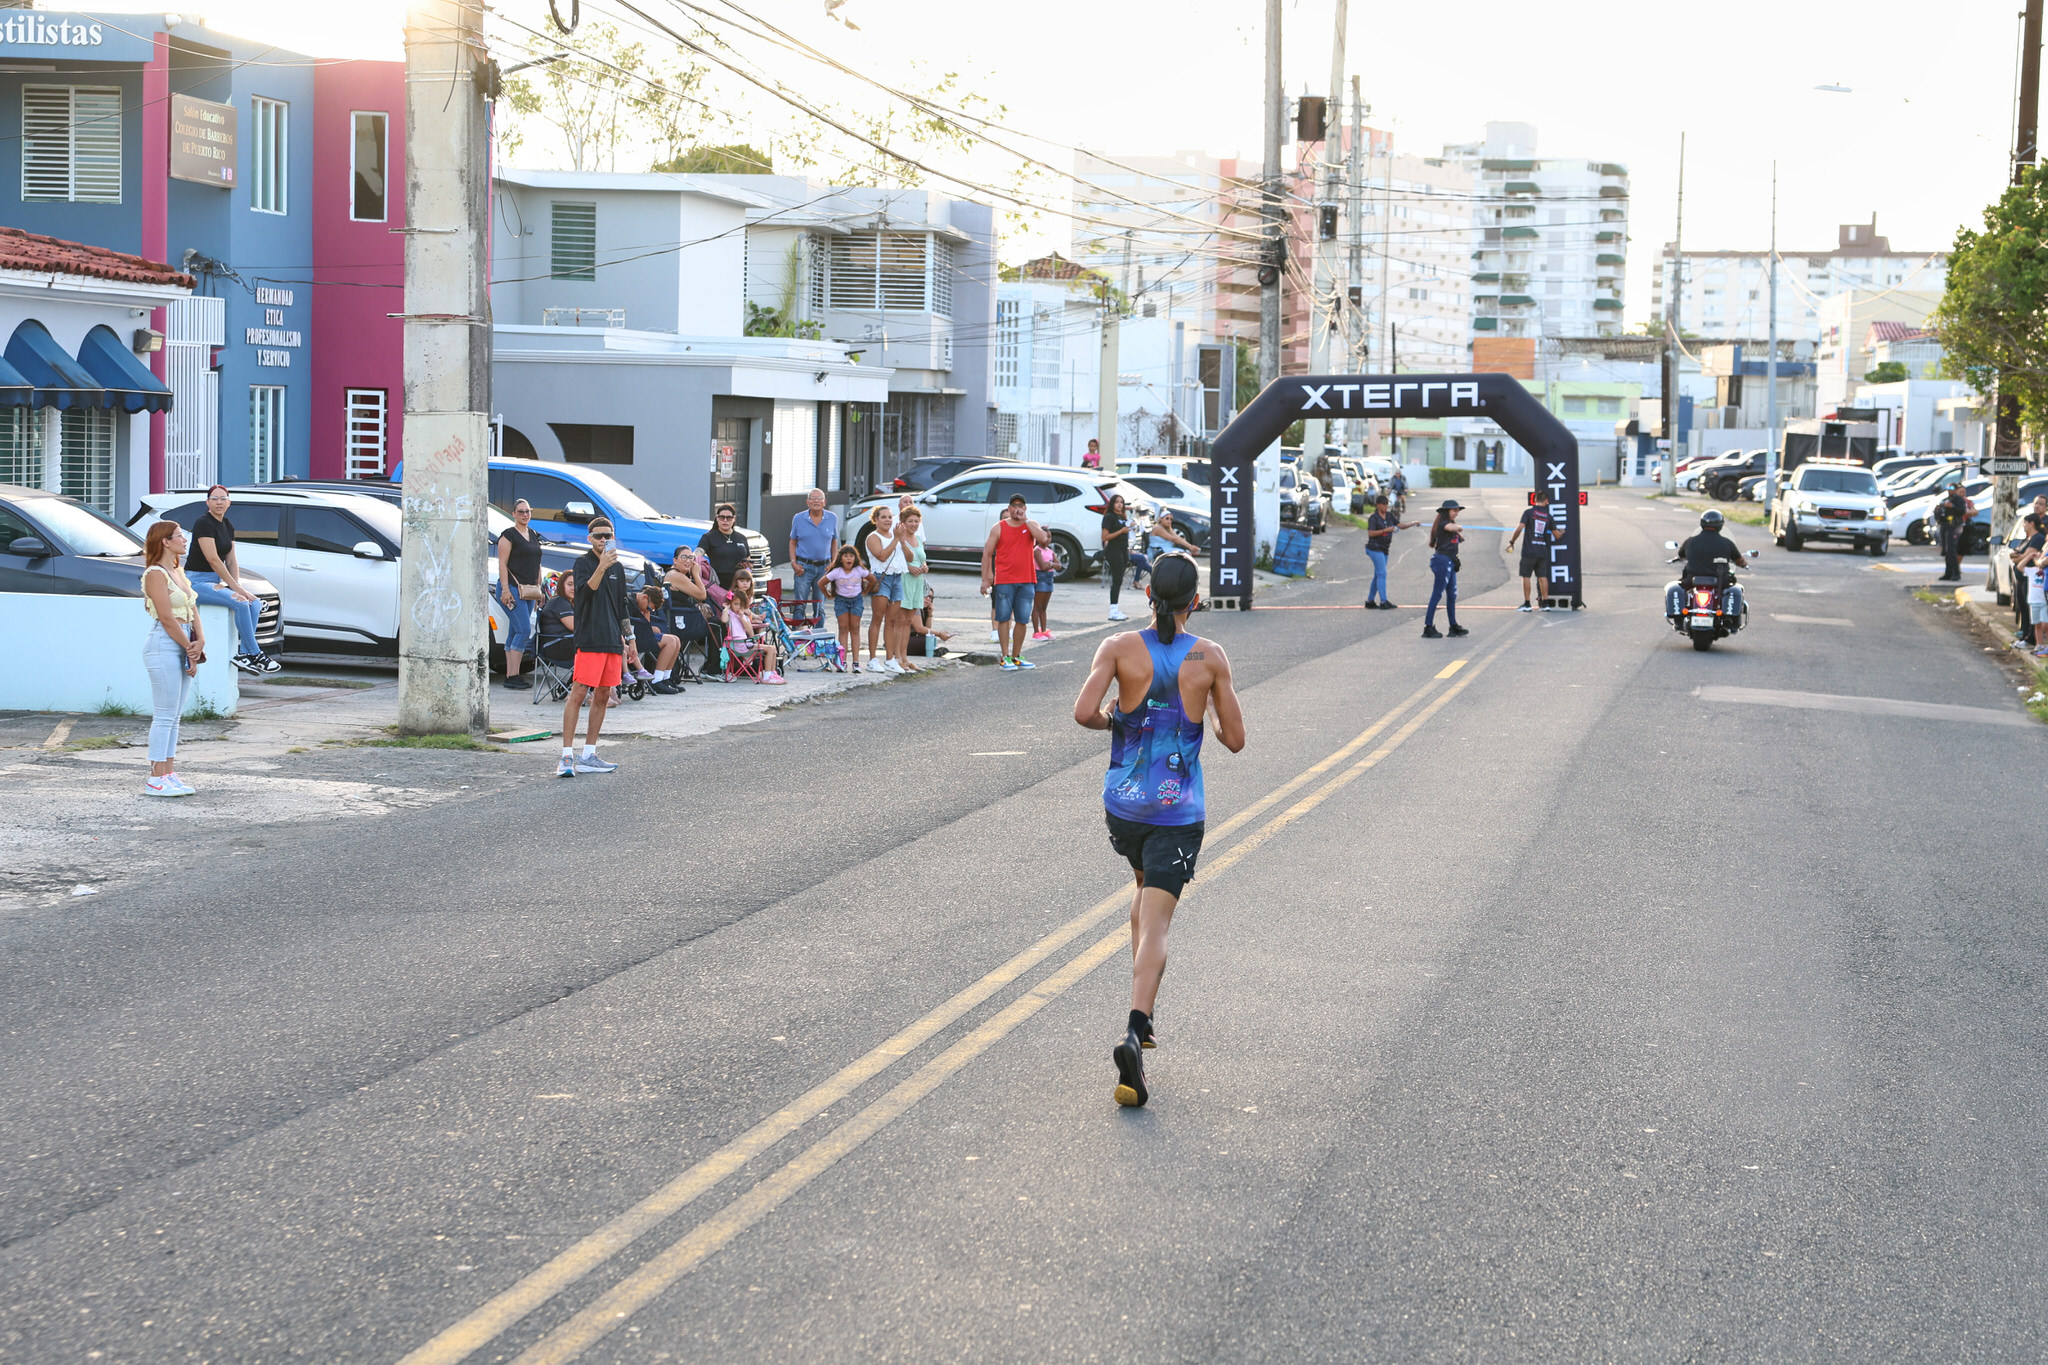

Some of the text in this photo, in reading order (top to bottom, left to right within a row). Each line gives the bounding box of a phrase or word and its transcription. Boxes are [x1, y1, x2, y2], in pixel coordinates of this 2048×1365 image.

[175, 121, 233, 145] COLEGIO DE BARBEROS
[182, 142, 226, 160] DE PUERTO RICO
[256, 287, 294, 306] HERMANDAD
[266, 309, 283, 326] ETICA
[246, 328, 301, 348] PROFESIONALISMO
[257, 349, 290, 367] Y SERVICIO
[1301, 382, 1479, 410] XTERRA
[1995, 462, 2026, 472] TRANSITO
[1220, 466, 1239, 586] XTERRA
